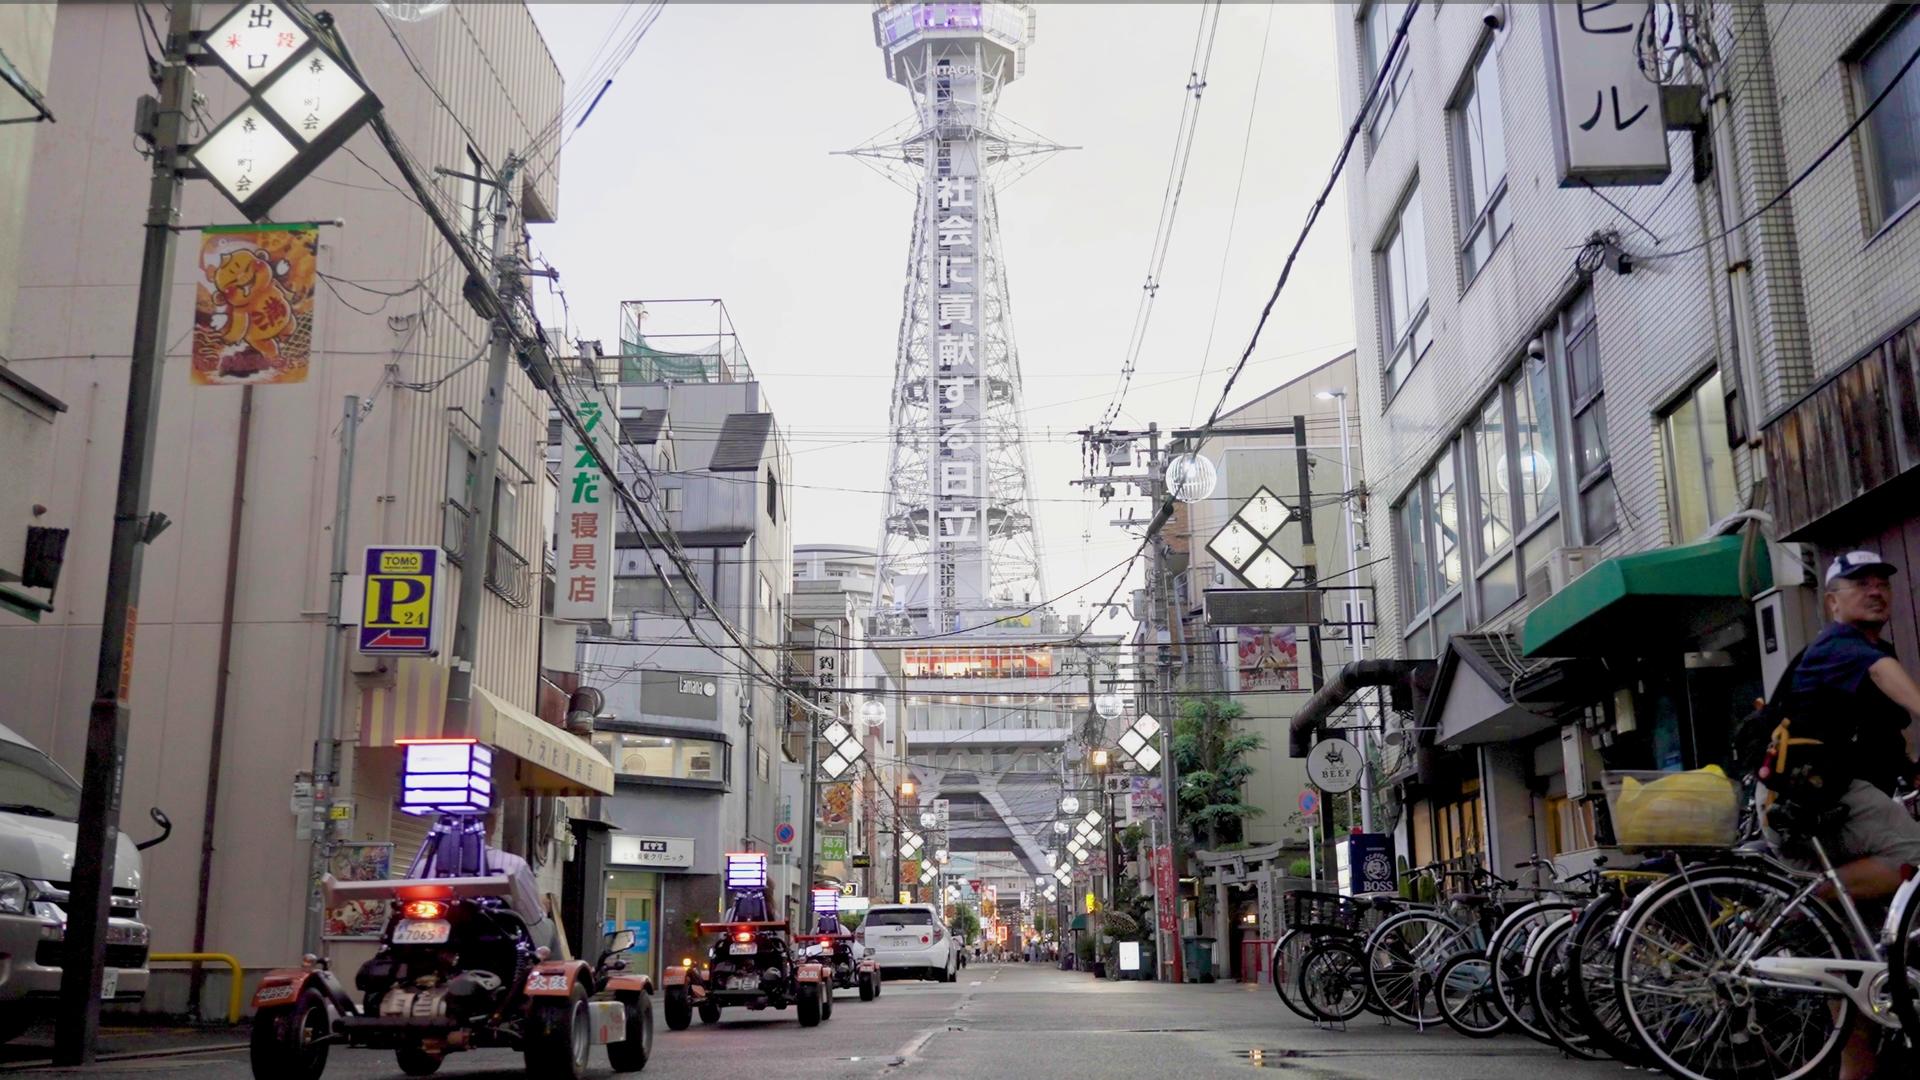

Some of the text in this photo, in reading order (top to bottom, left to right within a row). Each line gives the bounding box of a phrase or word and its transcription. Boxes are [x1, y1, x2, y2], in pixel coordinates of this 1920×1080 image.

[929, 65, 977, 75] HITACH
[936, 176, 977, 541] 社会に貢献する日立
[384, 556, 418, 566] TOMO
[1321, 769, 1351, 778] BEEF
[1362, 880, 1394, 891] BOSS
